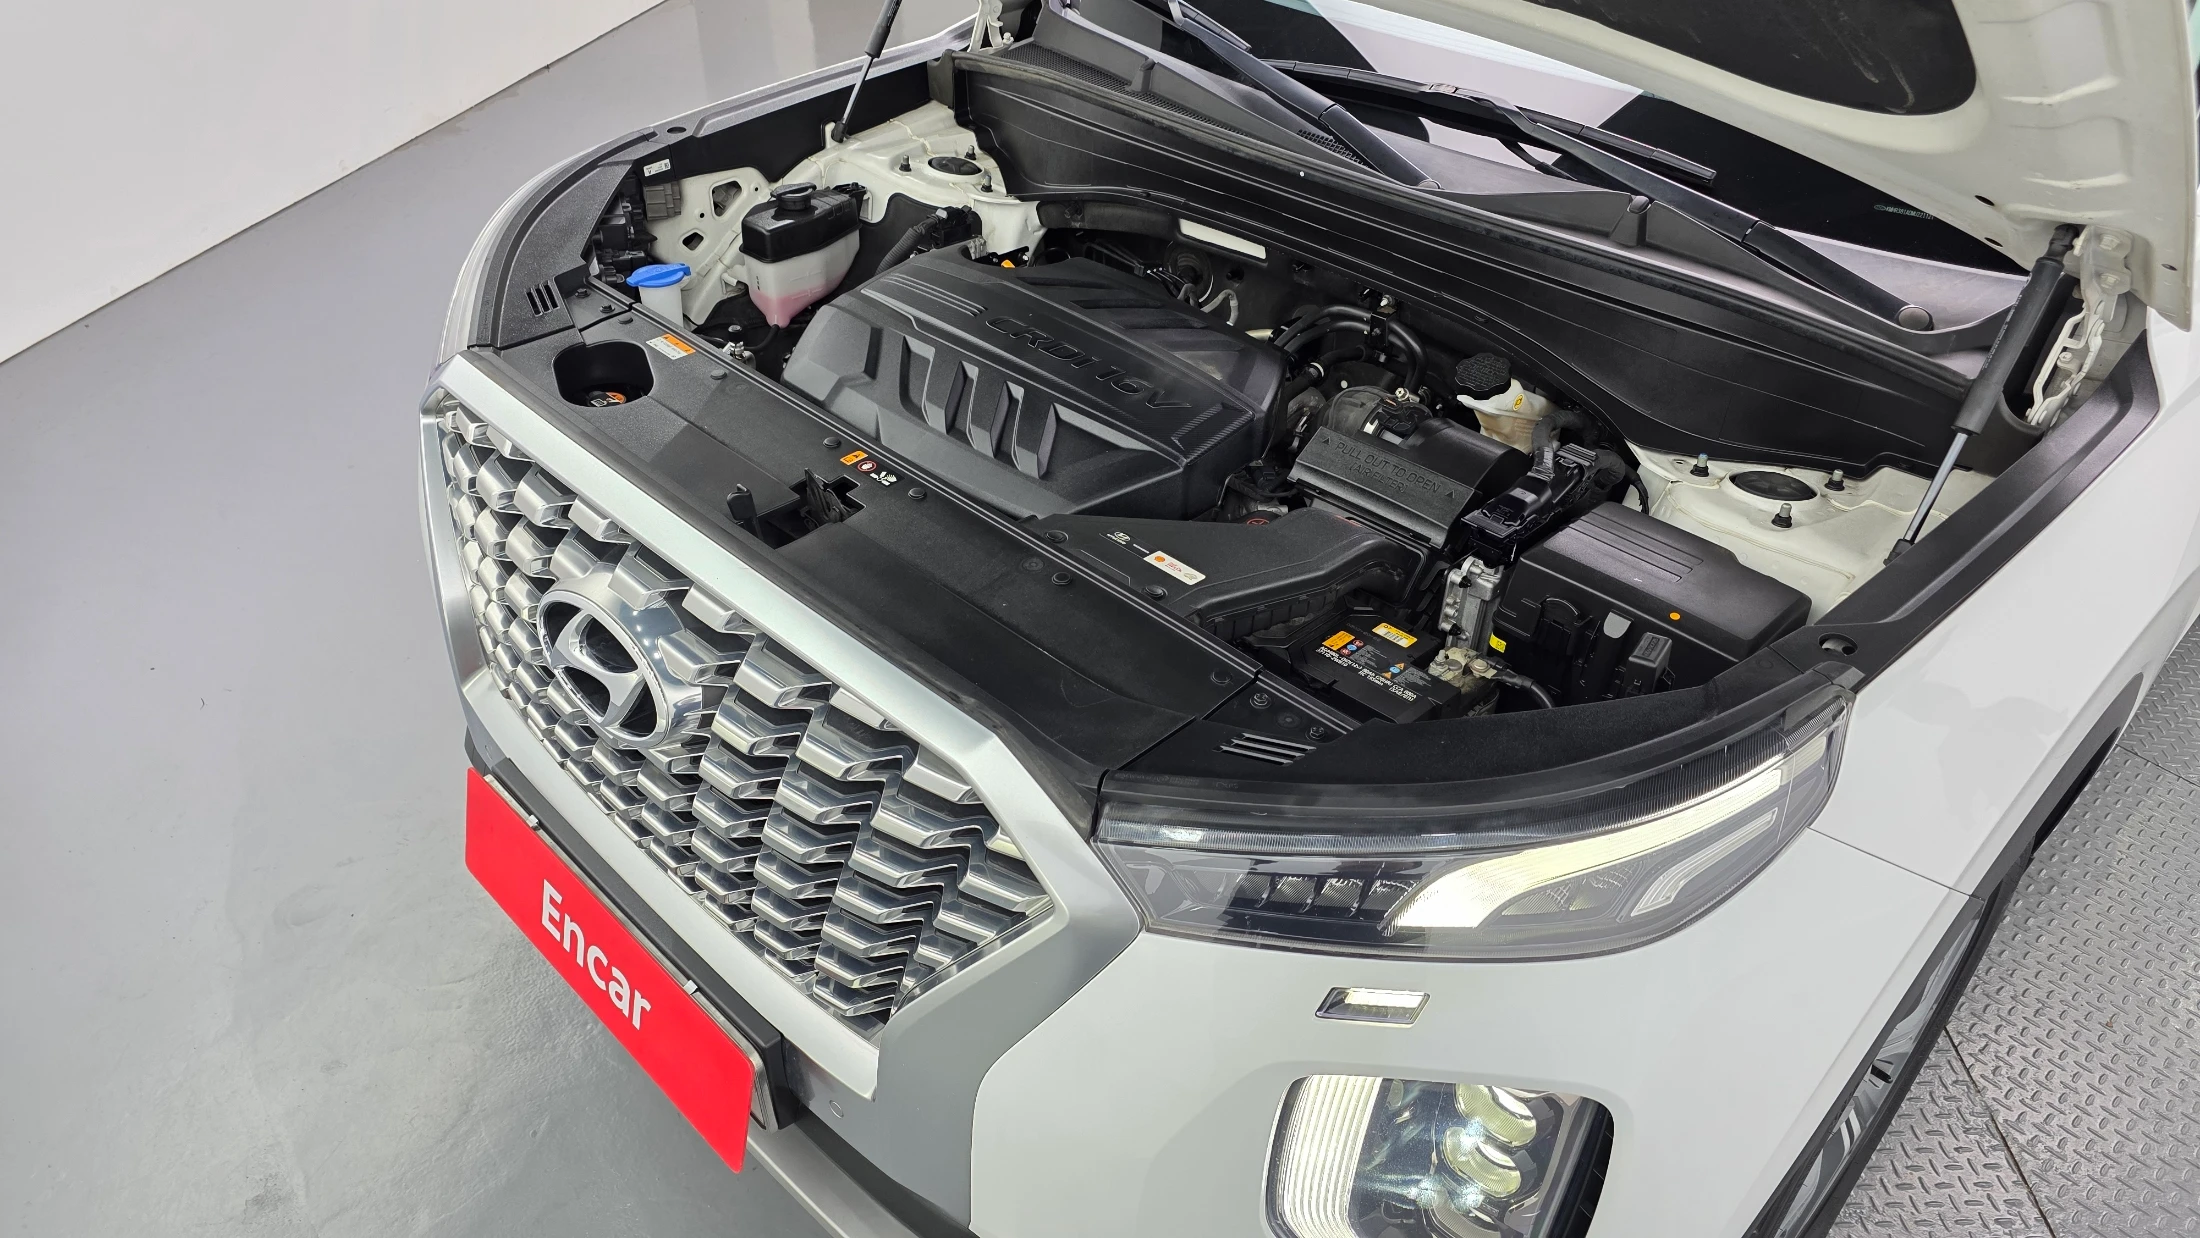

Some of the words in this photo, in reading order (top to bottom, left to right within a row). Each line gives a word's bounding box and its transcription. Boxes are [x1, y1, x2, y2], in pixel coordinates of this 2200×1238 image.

[985, 315, 1102, 369] CRDi
[1095, 365, 1193, 409] 16V
[1334, 441, 1362, 460] PULL
[1364, 453, 1391, 470] OUT
[1391, 464, 1407, 478] TO
[1406, 472, 1442, 494] OPEN
[541, 879, 651, 1030] Encar
